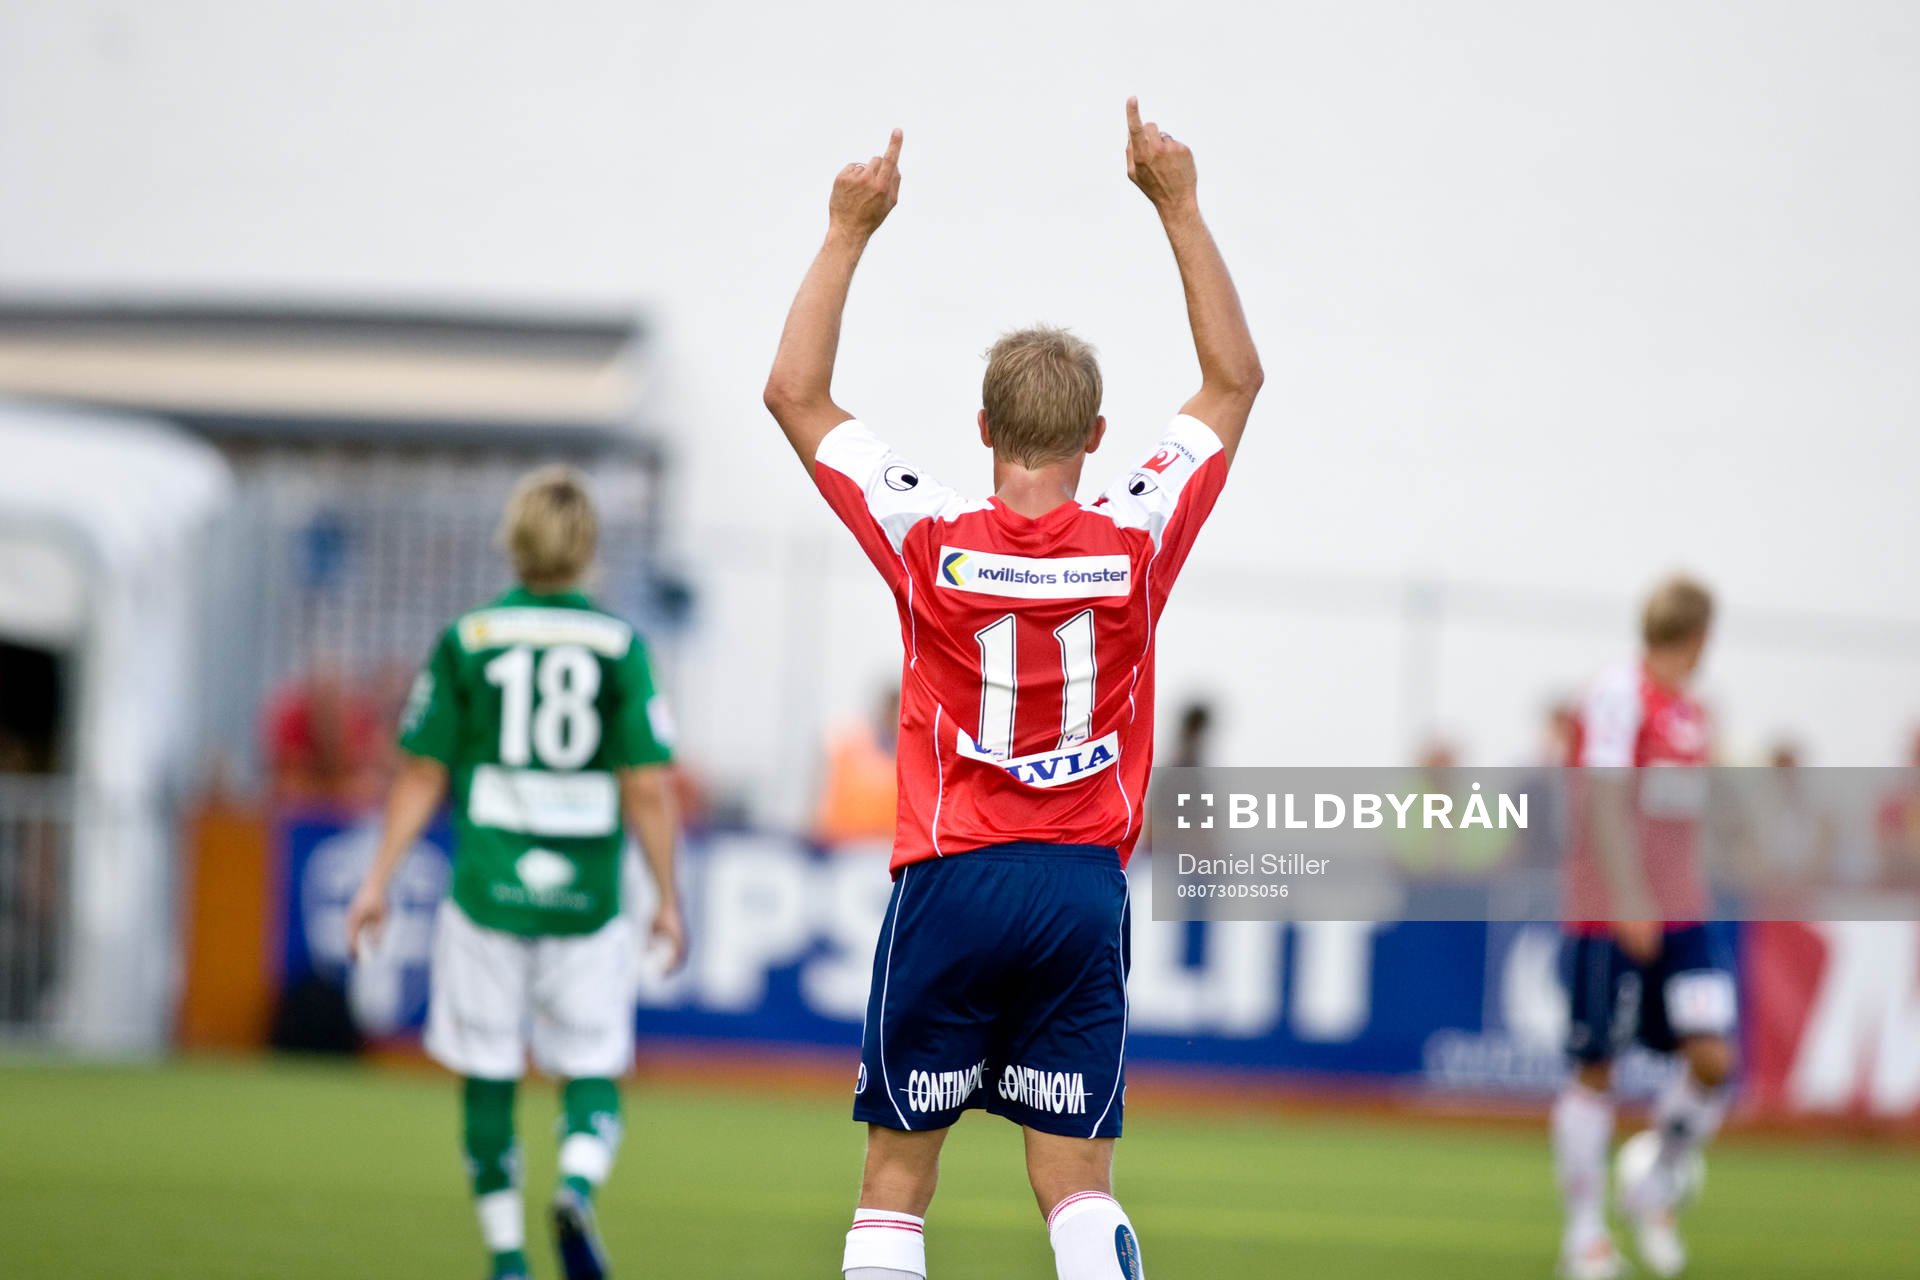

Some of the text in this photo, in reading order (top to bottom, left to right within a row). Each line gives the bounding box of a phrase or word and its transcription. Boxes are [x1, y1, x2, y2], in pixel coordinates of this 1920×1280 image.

[1063, 569, 1128, 584] fönster
[484, 643, 601, 770] 18
[974, 608, 1097, 760] 11
